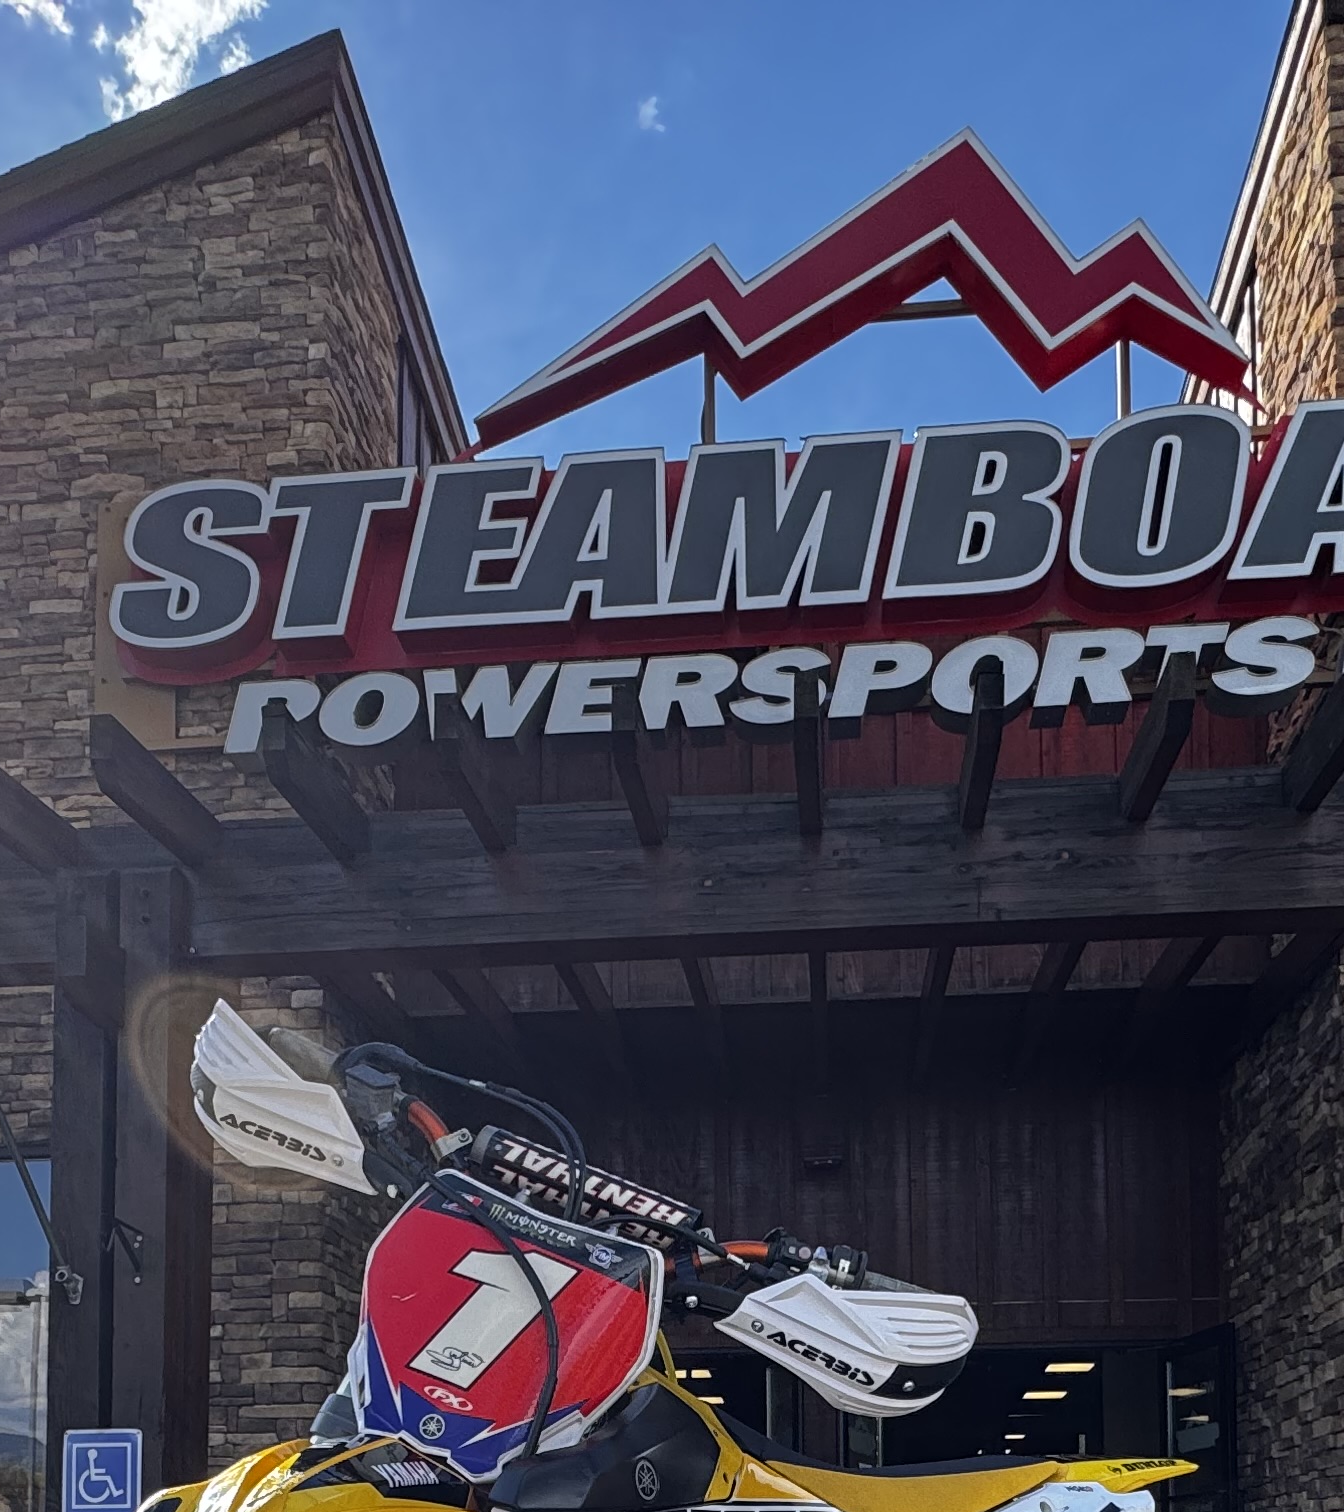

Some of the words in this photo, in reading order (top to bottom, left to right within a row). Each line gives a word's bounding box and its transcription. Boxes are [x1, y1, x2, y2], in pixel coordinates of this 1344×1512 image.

[223, 615, 1320, 756] POWERSPORTS
[405, 1248, 584, 1392] 1
[371, 1460, 440, 1488] YAMAHA
[1121, 1459, 1177, 1473] DUNLOP
